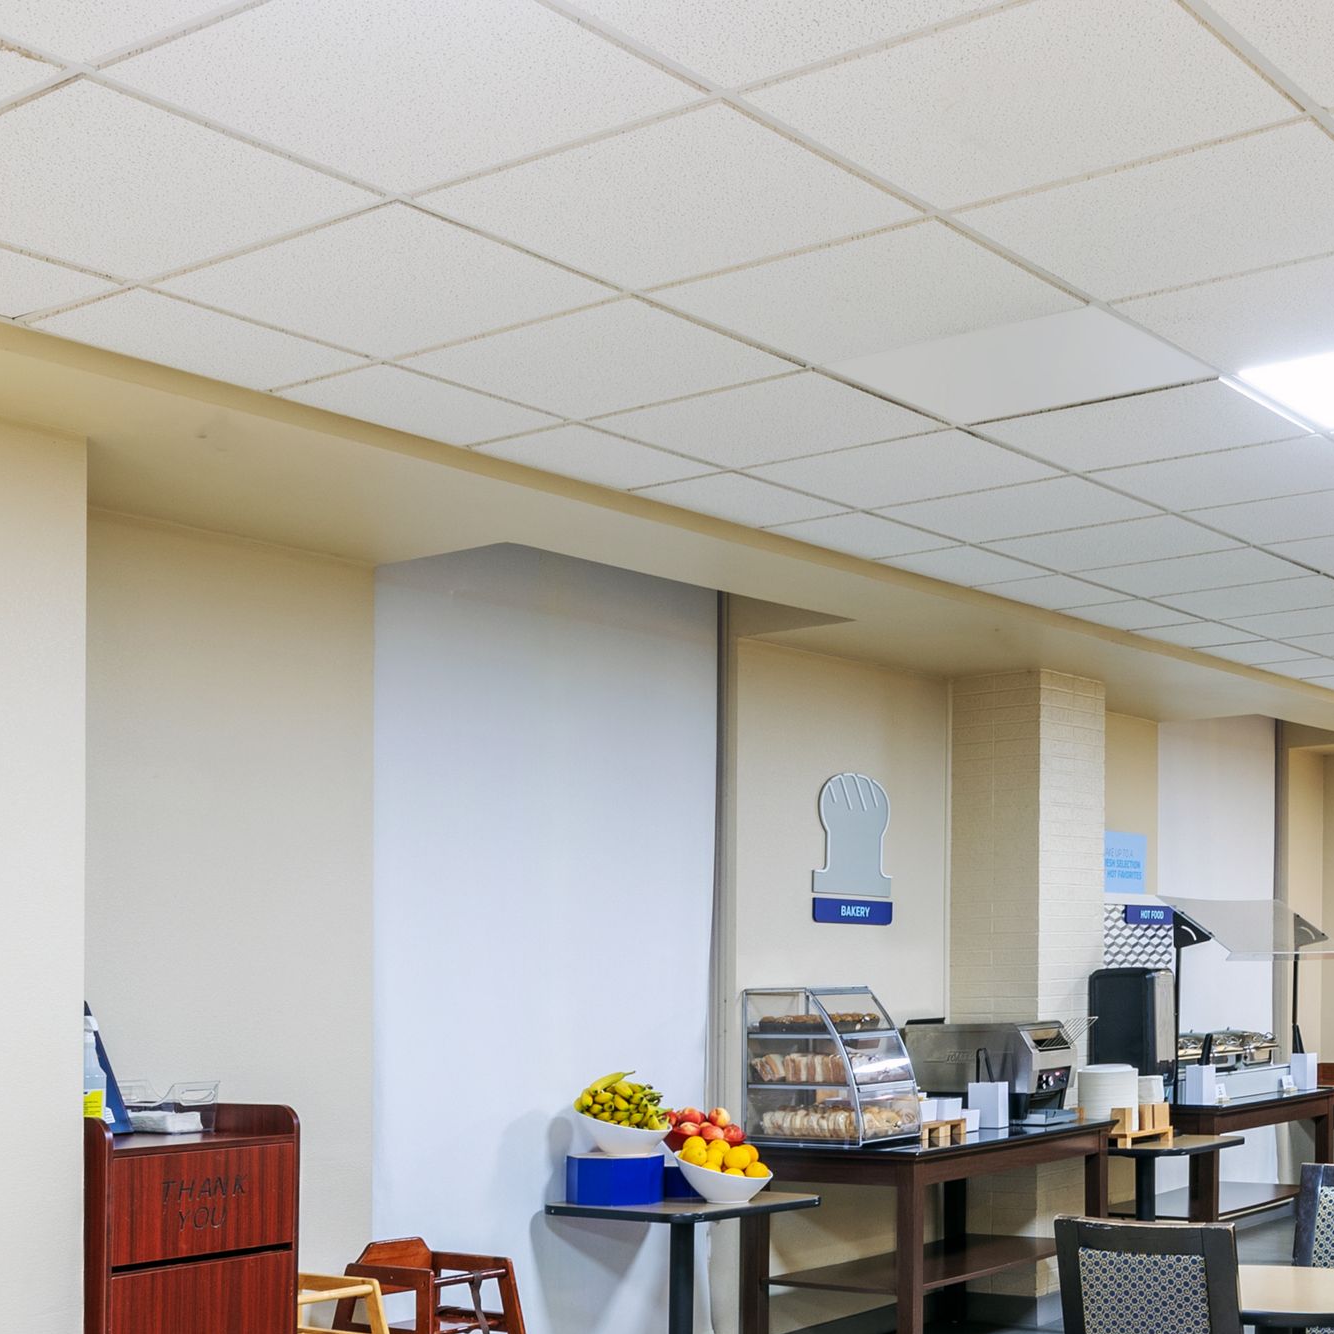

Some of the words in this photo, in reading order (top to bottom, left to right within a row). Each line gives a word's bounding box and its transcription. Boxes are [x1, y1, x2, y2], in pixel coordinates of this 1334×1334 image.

[840, 904, 871, 917] BAKERY
[1140, 909, 1150, 919] HOT
[1151, 910, 1165, 920] FOOD
[162, 1174, 247, 1203] THANK
[178, 1206, 227, 1232] YOU
